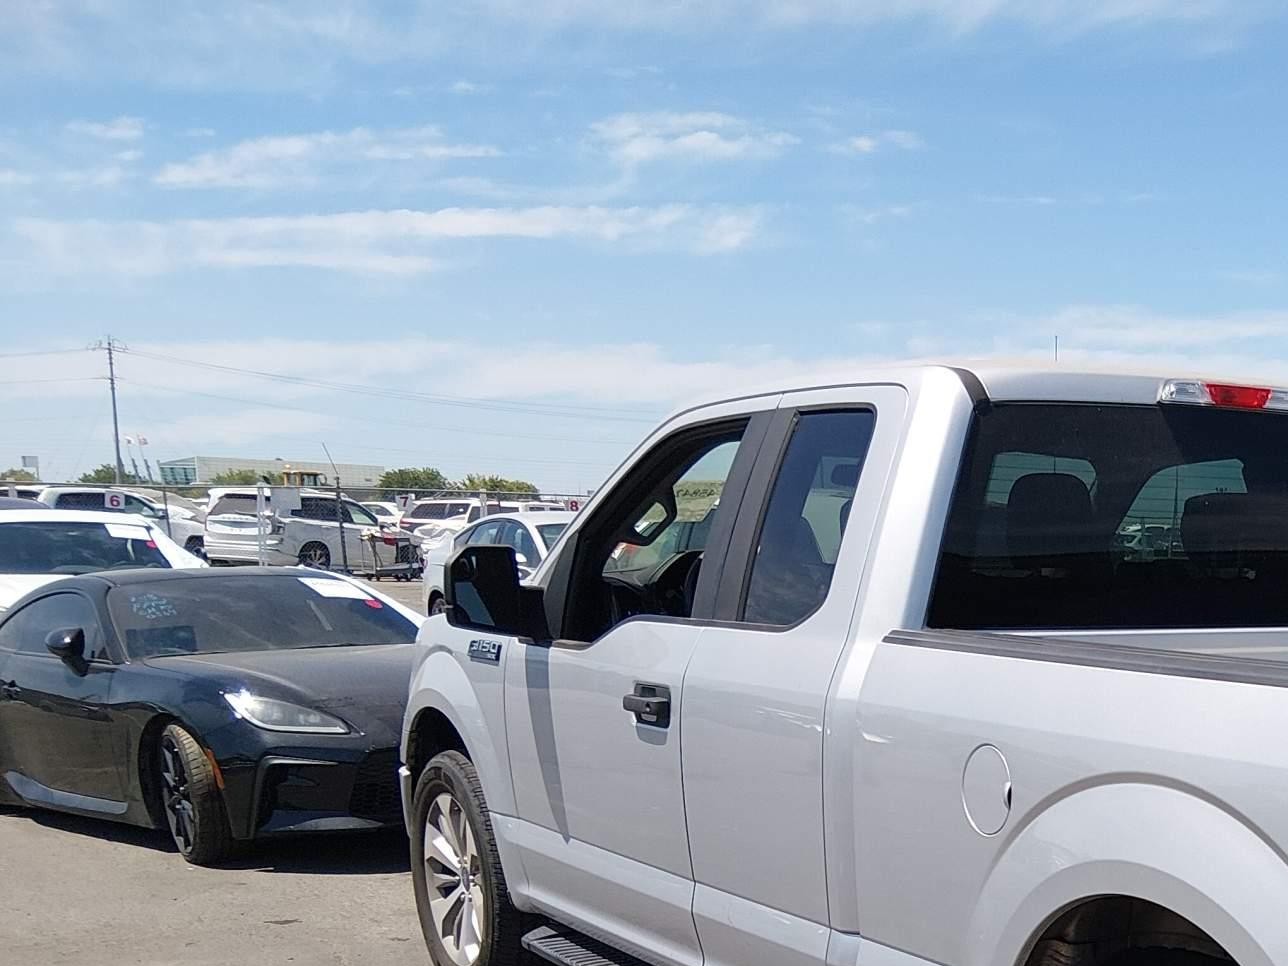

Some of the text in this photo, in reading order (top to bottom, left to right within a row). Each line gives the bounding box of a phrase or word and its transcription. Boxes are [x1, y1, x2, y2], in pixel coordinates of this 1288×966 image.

[109, 494, 121, 507] 6
[399, 496, 409, 507] 7
[569, 500, 579, 512] 8
